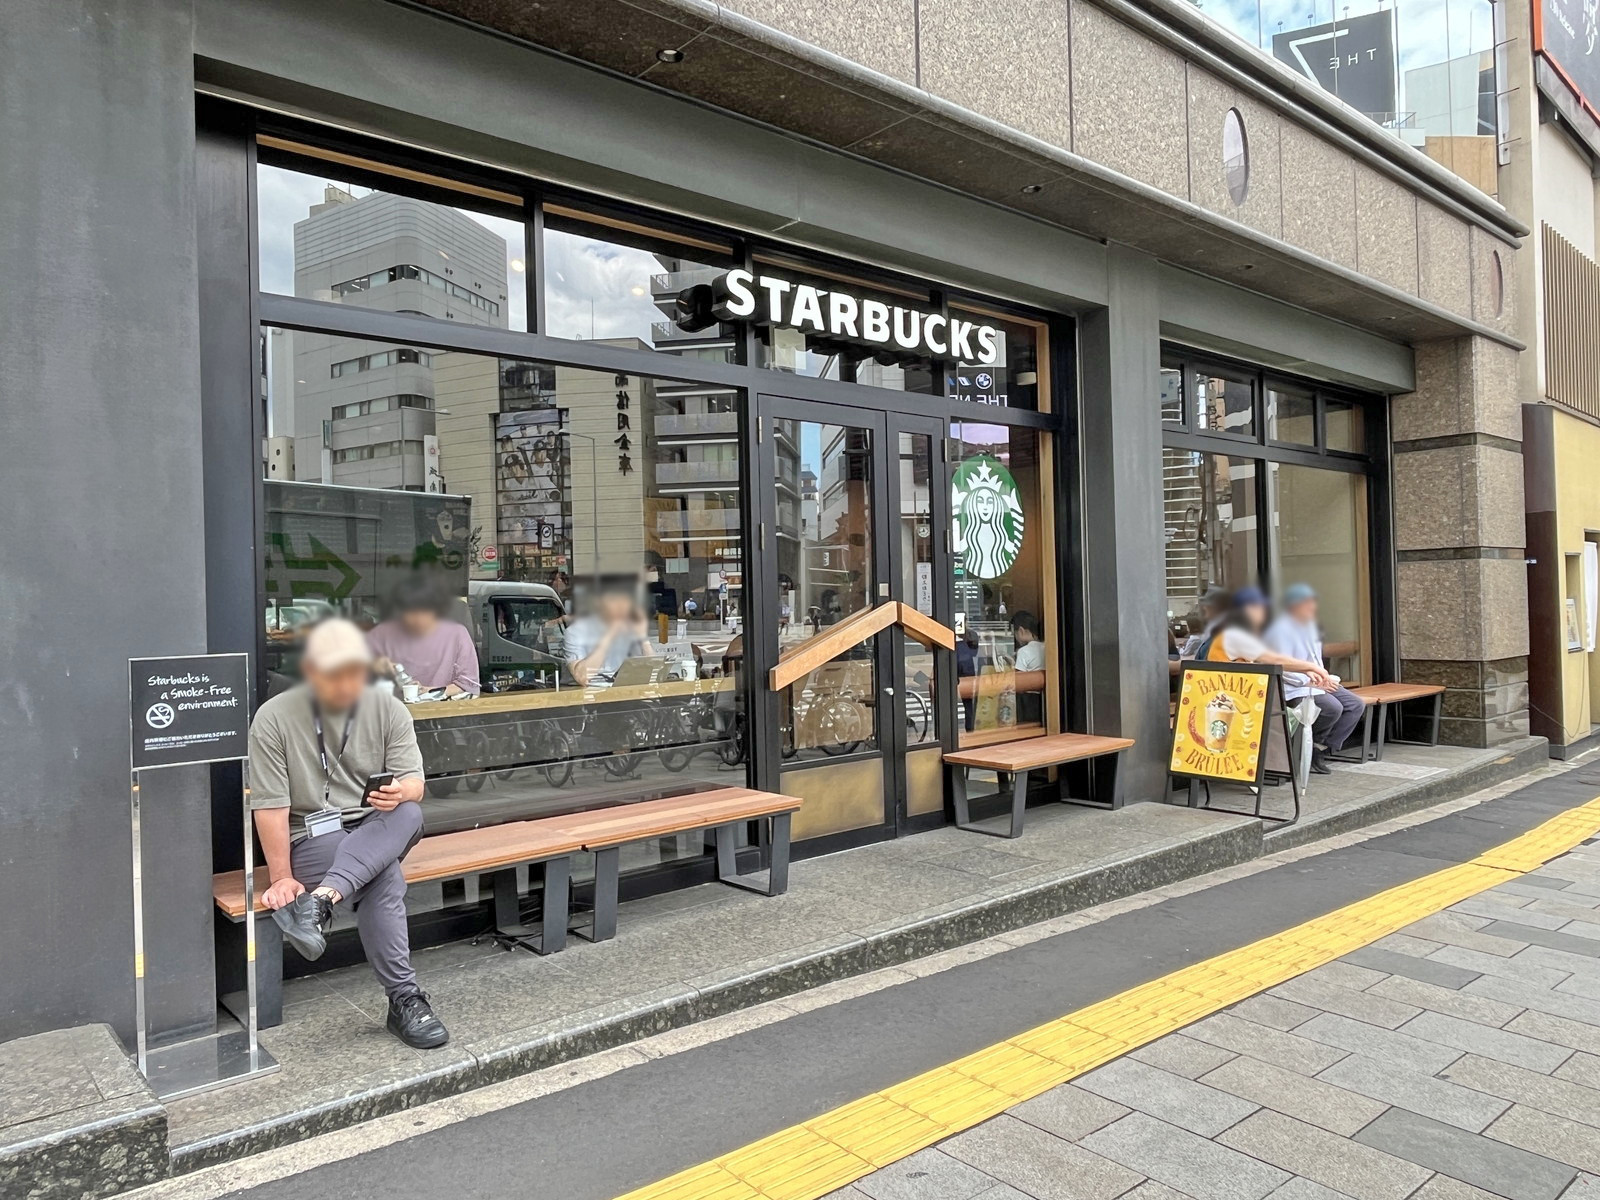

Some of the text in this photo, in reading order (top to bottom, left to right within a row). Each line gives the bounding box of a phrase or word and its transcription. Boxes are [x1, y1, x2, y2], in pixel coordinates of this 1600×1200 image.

[726, 268, 998, 365] STARBUCKS
[147, 672, 210, 686] Starbucks is
[1196, 673, 1255, 699] BANANA
[160, 692, 169, 700] a
[1185, 748, 1244, 775] BRÛLÉE
